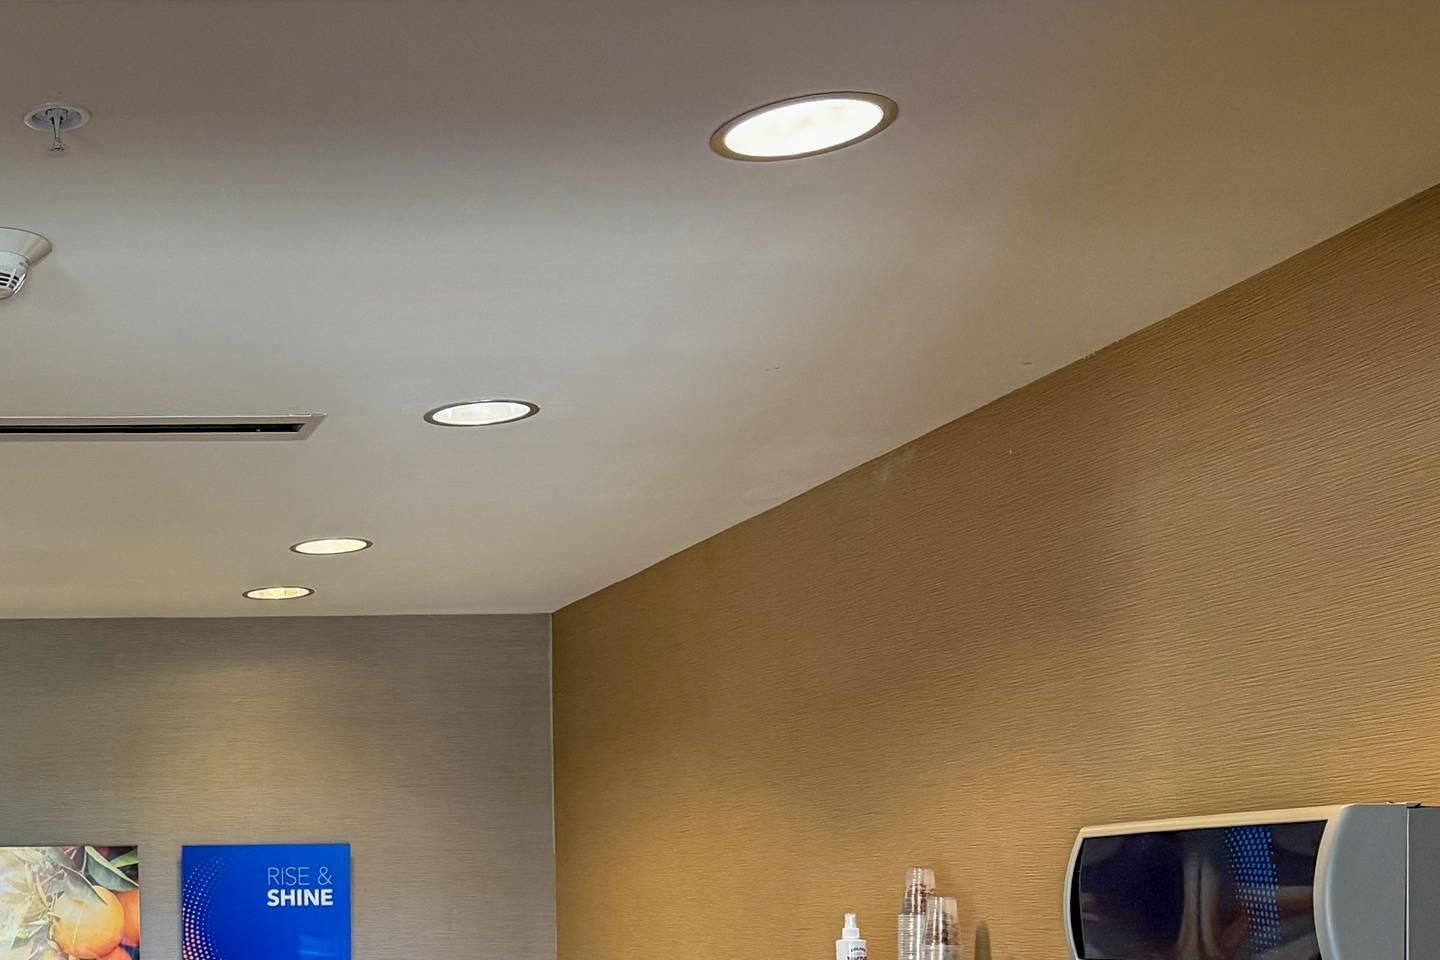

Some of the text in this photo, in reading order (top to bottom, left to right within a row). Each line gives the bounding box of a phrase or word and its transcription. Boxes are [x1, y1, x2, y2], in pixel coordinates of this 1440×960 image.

[268, 867, 332, 886] RISE &
[267, 889, 333, 906] SHINE
